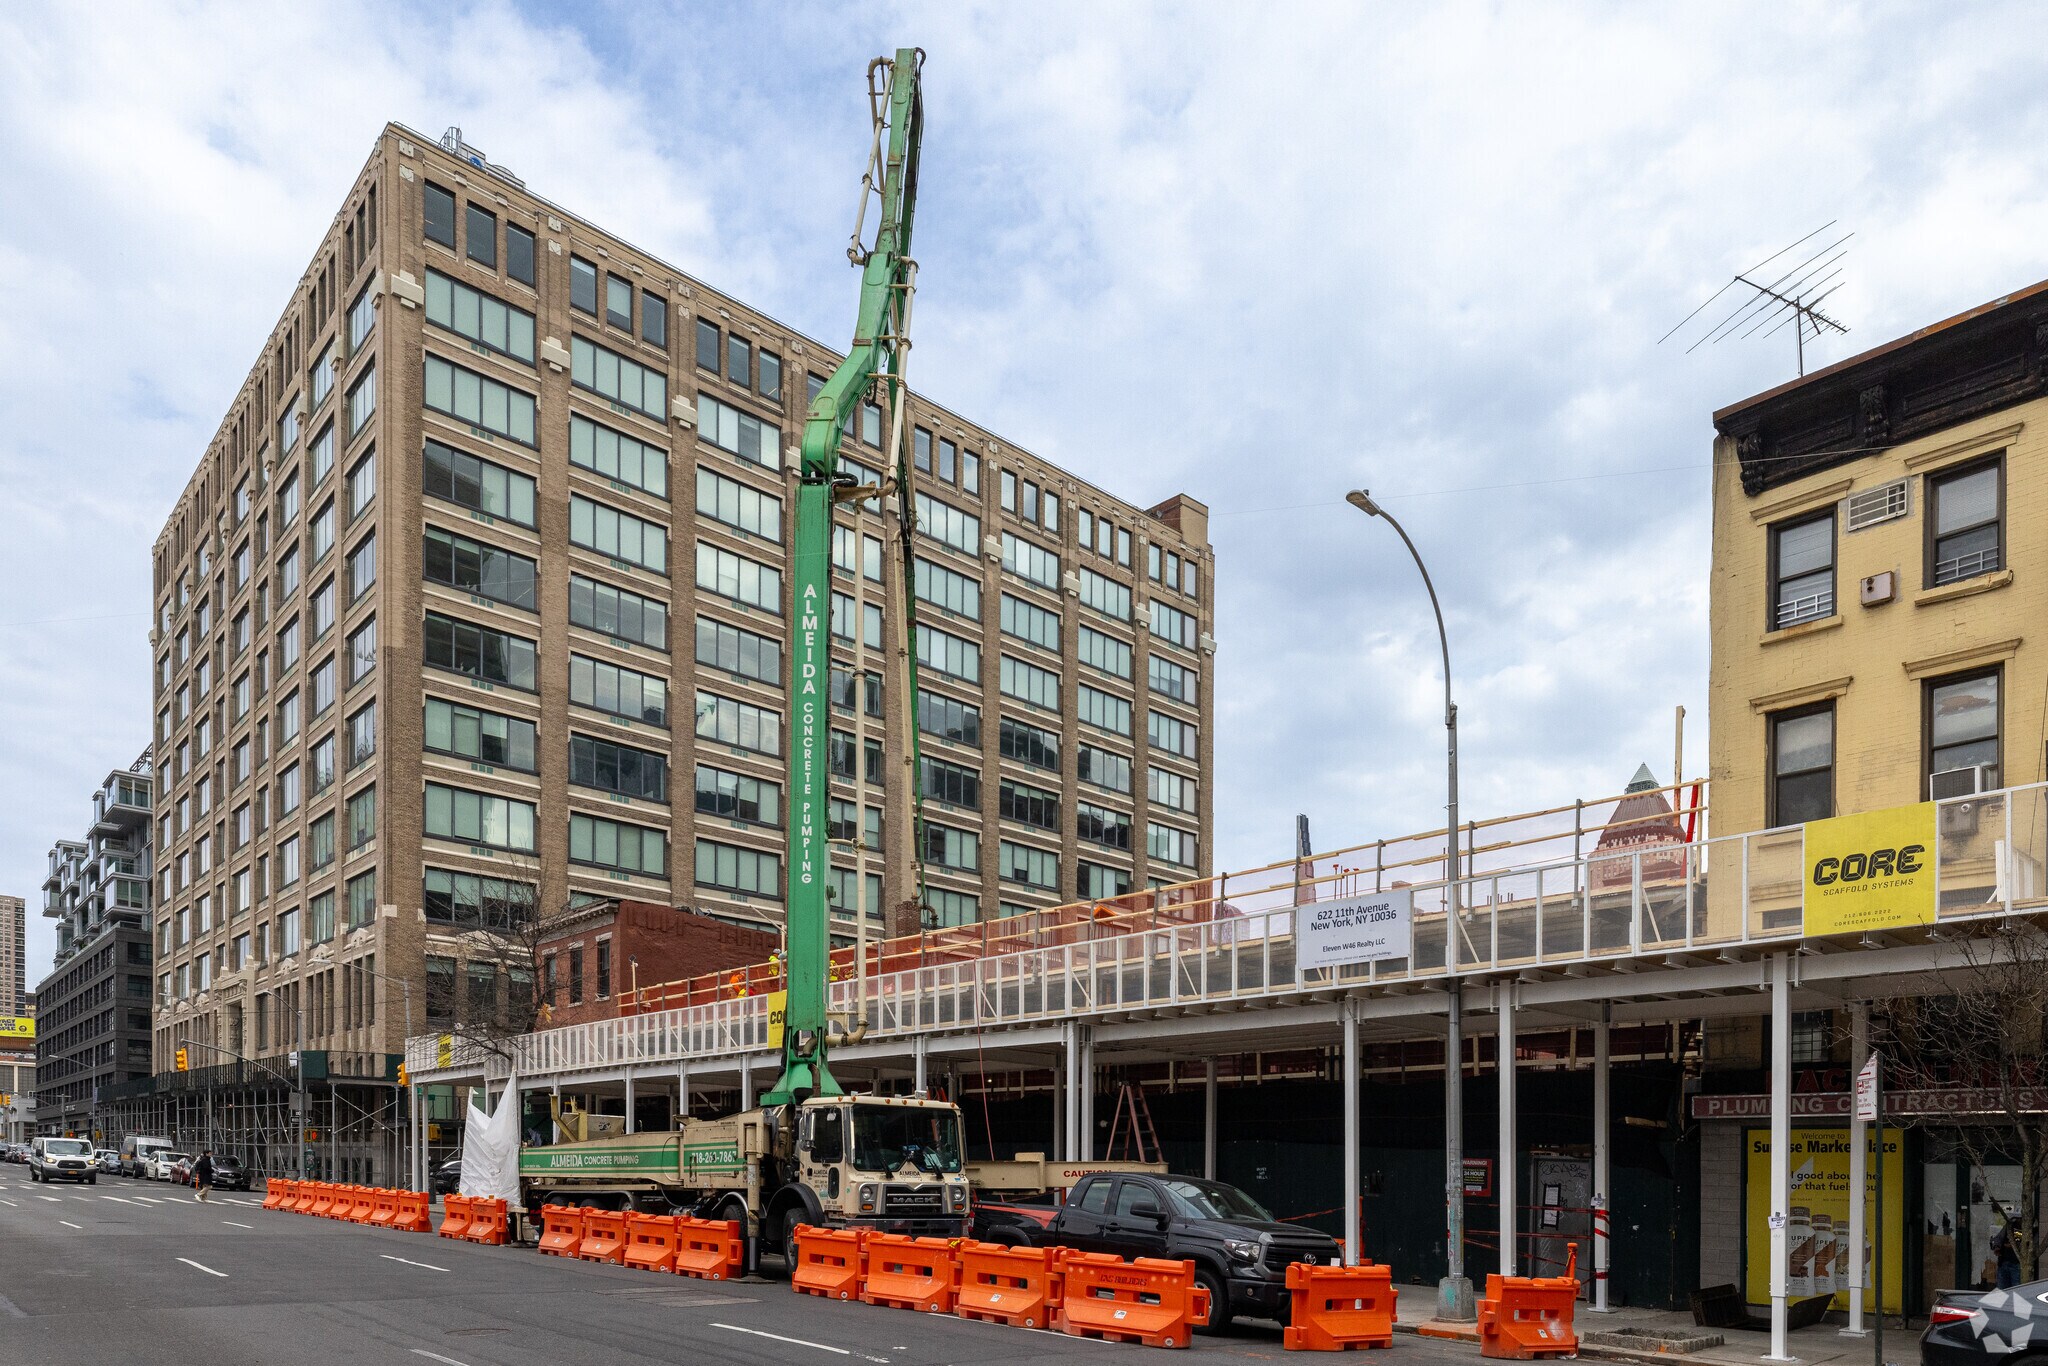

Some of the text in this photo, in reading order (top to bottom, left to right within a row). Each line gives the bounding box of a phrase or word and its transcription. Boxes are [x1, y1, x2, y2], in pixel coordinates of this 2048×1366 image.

[801, 584, 818, 884] ALMEIDA CONCRETE PUMPING
[1813, 844, 1926, 886] CORE
[1823, 878, 1914, 896] SCAFFOLD SYSTEMS
[1317, 902, 1389, 920] 622 11th Avenue
[1310, 910, 1397, 931] New York, NY 10036
[1834, 915, 1902, 927] CORESCAFFOLD.COM
[1322, 937, 1386, 953] Eleven W46 Realty LLC
[770, 1010, 785, 1025] CO
[1708, 1096, 1824, 1115] PLUMNG
[1801, 1132, 1835, 1140] Welcome
[1753, 1140, 1803, 1153] Suse
[550, 1154, 639, 1168] ALMEIDA CONCRETE PUMPING
[1796, 1171, 1824, 1182] good
[1827, 1171, 1851, 1180] abou
[1805, 1182, 1826, 1191] that
[1828, 1182, 1851, 1191] fuel
